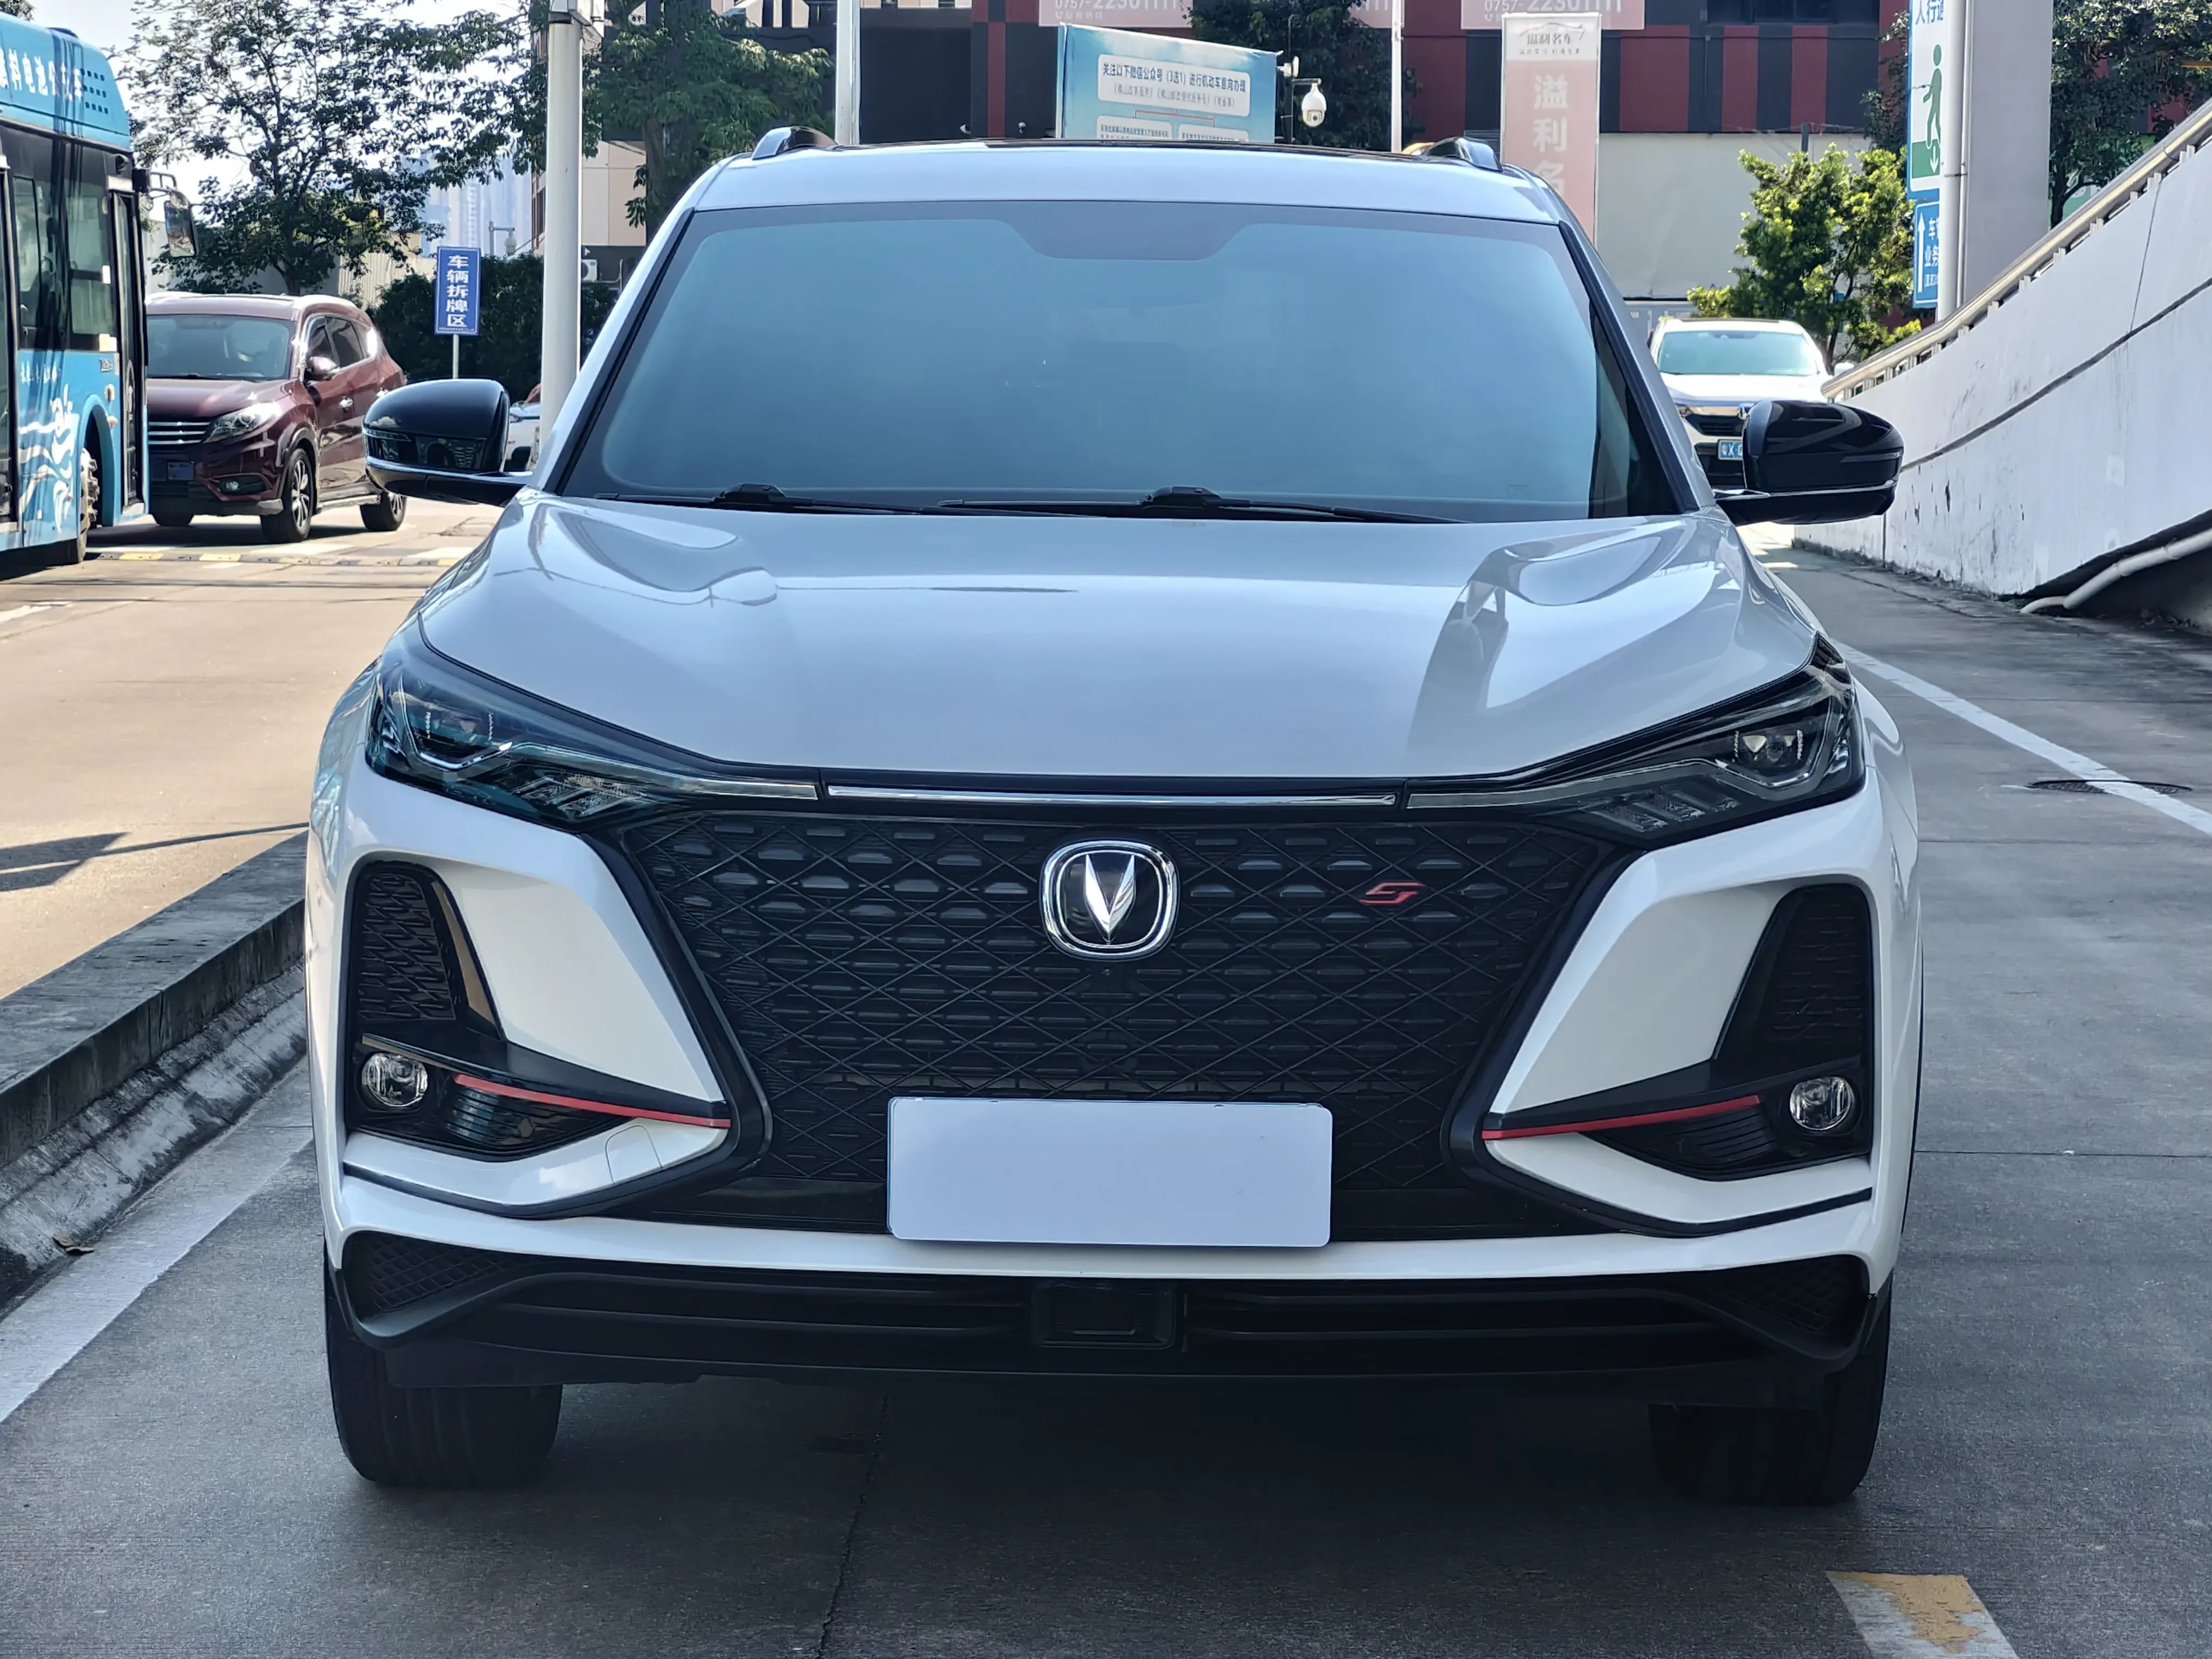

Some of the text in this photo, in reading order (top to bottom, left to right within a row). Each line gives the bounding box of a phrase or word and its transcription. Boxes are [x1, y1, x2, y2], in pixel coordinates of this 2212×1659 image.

[446, 255, 469, 327] 车辆拆牌区
